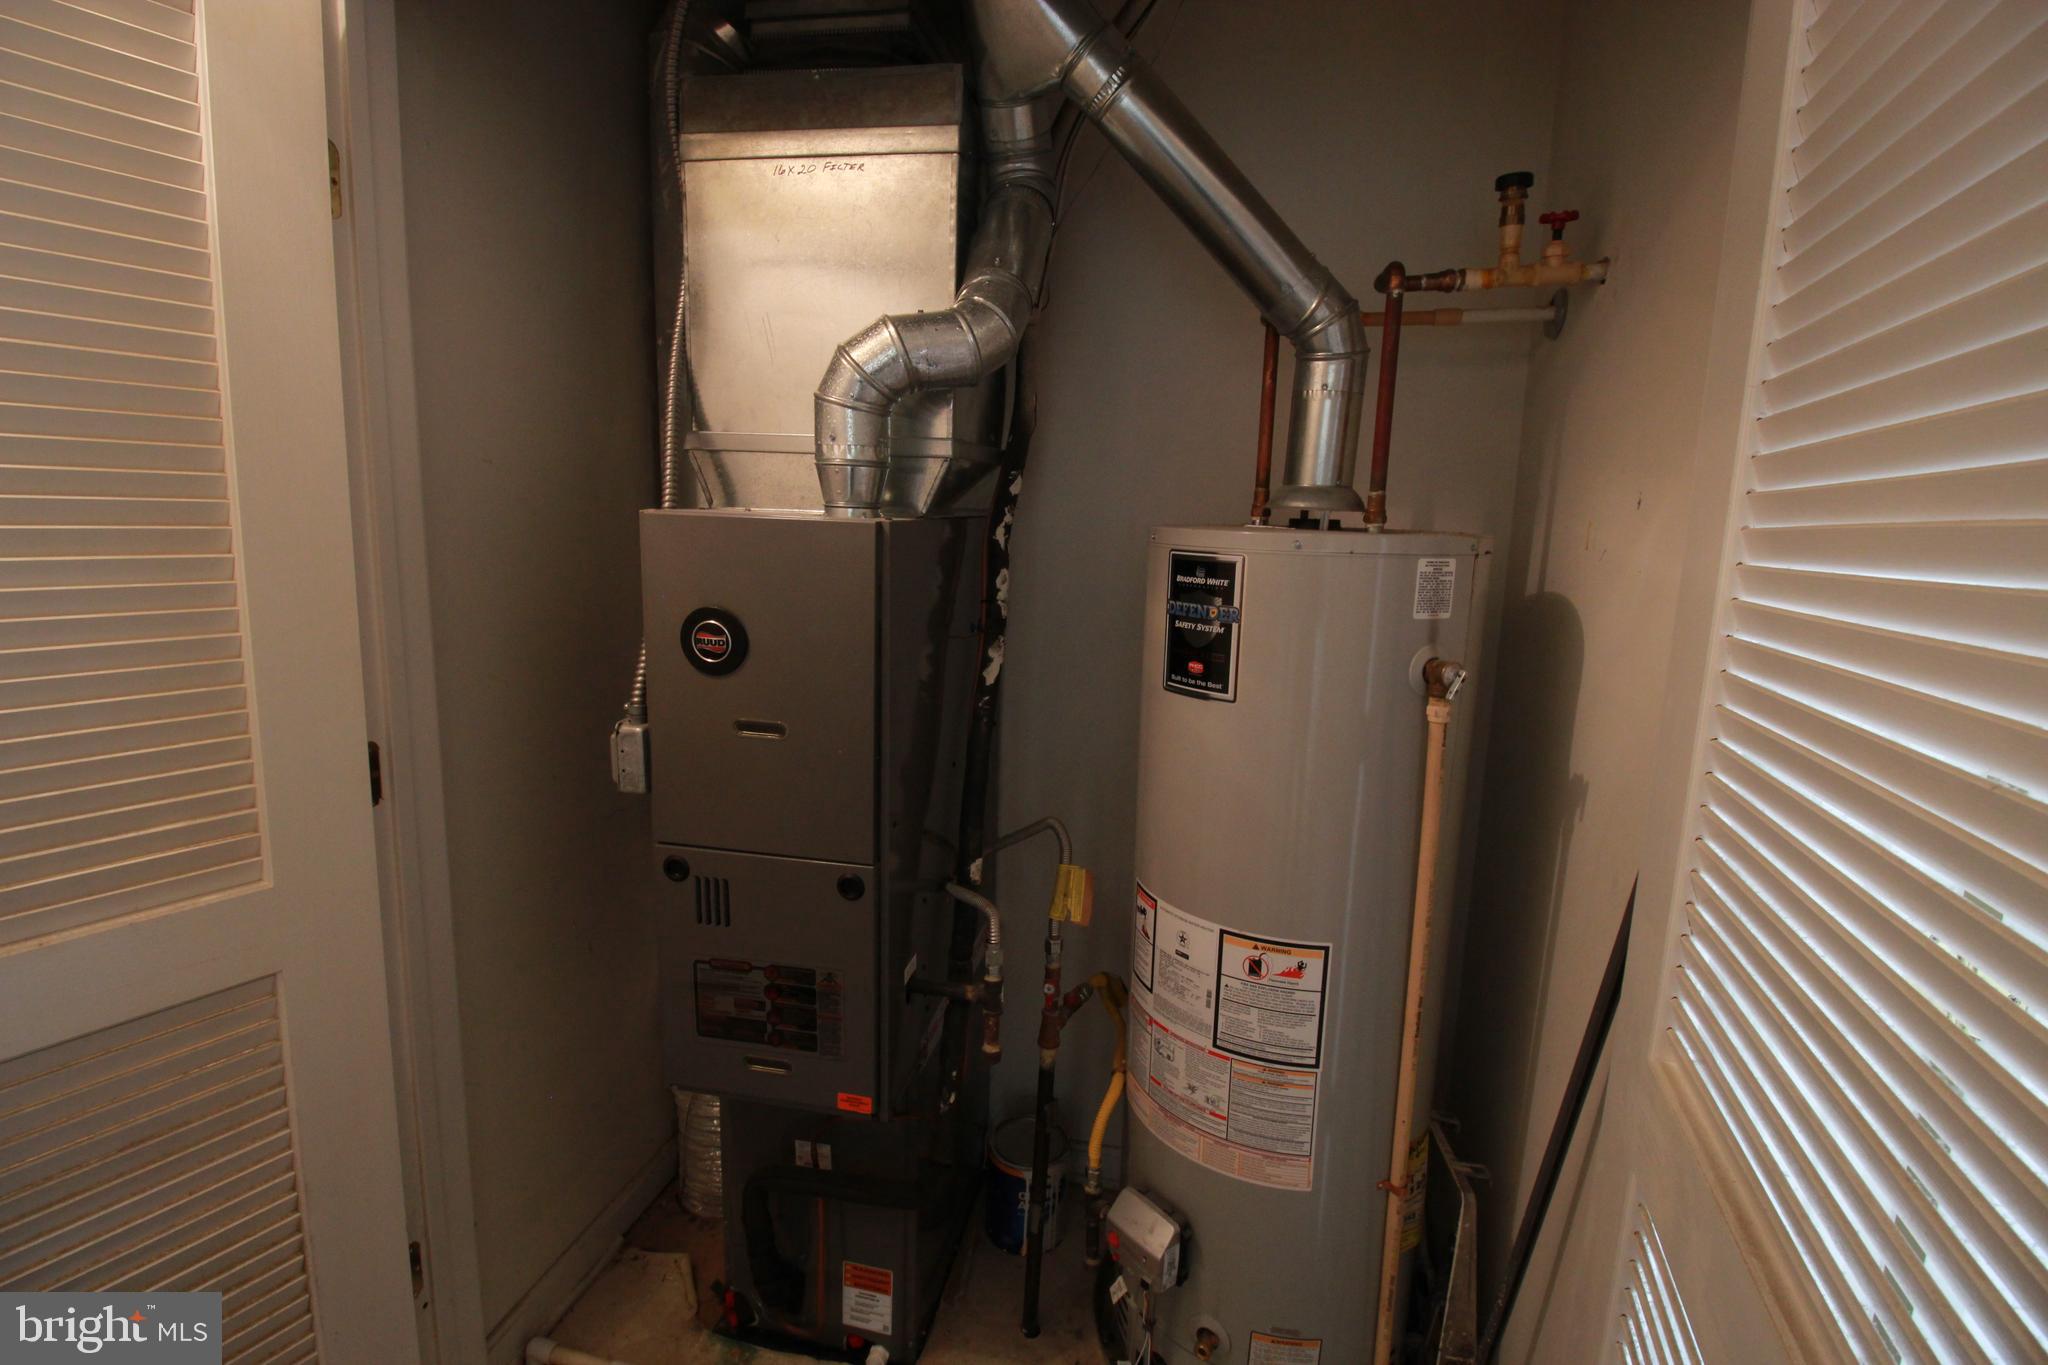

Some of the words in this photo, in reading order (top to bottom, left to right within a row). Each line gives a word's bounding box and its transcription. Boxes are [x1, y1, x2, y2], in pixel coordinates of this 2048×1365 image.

[822, 161, 865, 173] FILTER
[1177, 574, 1206, 585] BRADFORD
[1207, 577, 1230, 587] WHITE
[1168, 600, 1240, 623] DEFENDER
[1175, 619, 1196, 630] SAFETY
[1196, 623, 1225, 634] SYSTEM
[696, 637, 725, 647] RUUD
[1261, 945, 1292, 956] WARNING
